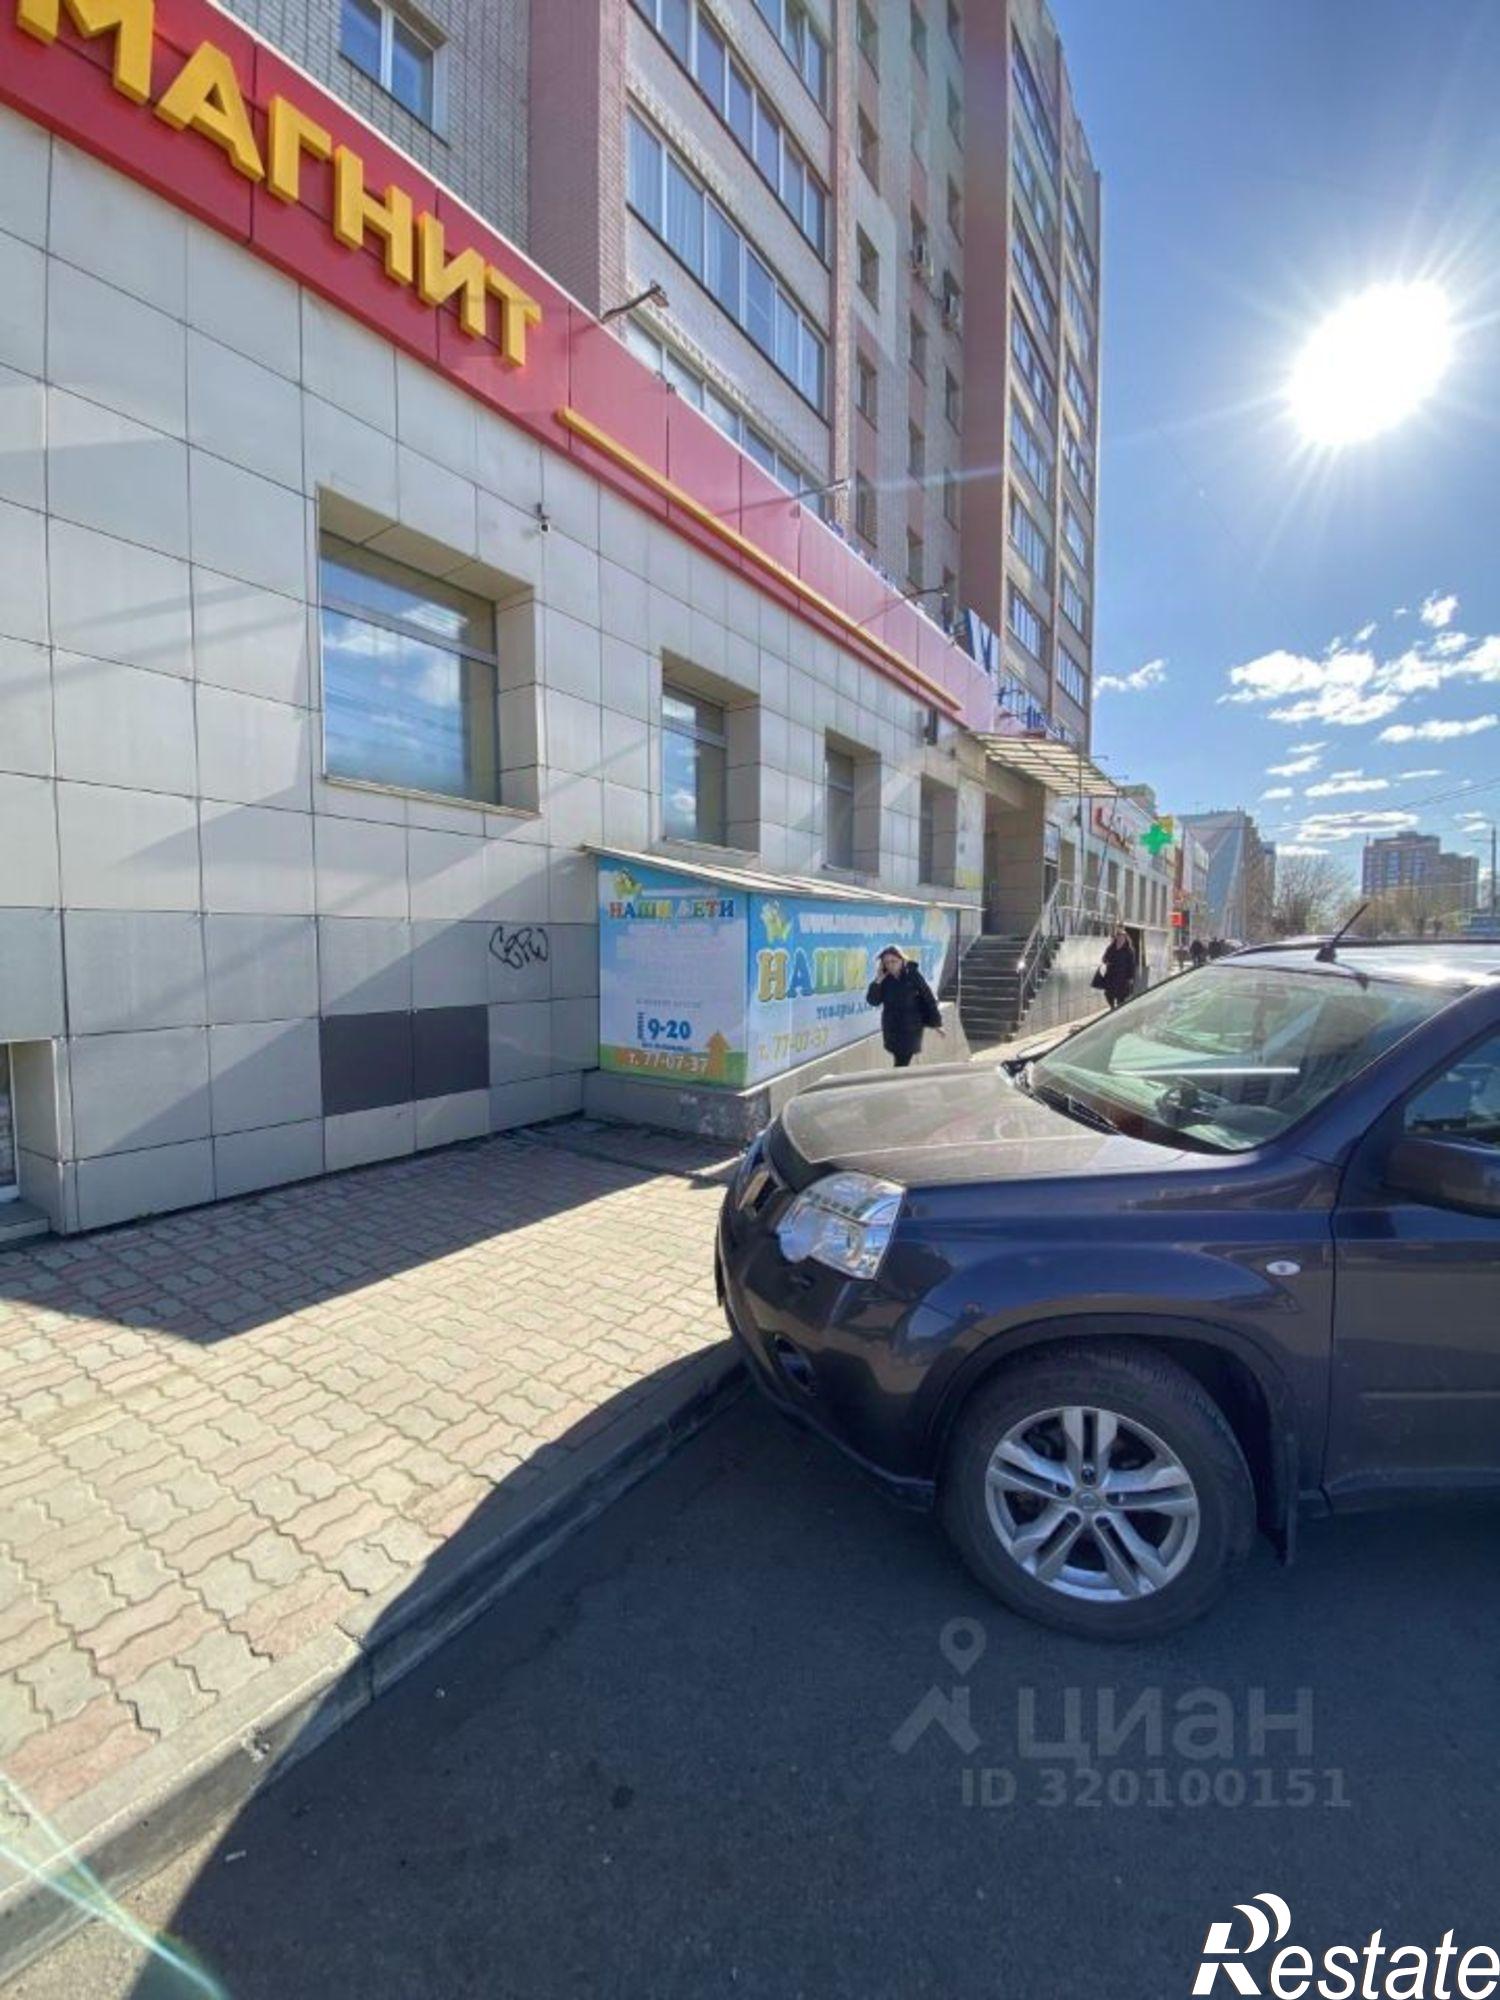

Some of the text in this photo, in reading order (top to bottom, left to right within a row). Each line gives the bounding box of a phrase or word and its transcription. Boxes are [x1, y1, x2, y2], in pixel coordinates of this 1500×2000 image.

[17, 0, 541, 368] МАГНИТ
[758, 949, 868, 1002] НАШИ
[647, 1018, 692, 1040] 9-20
